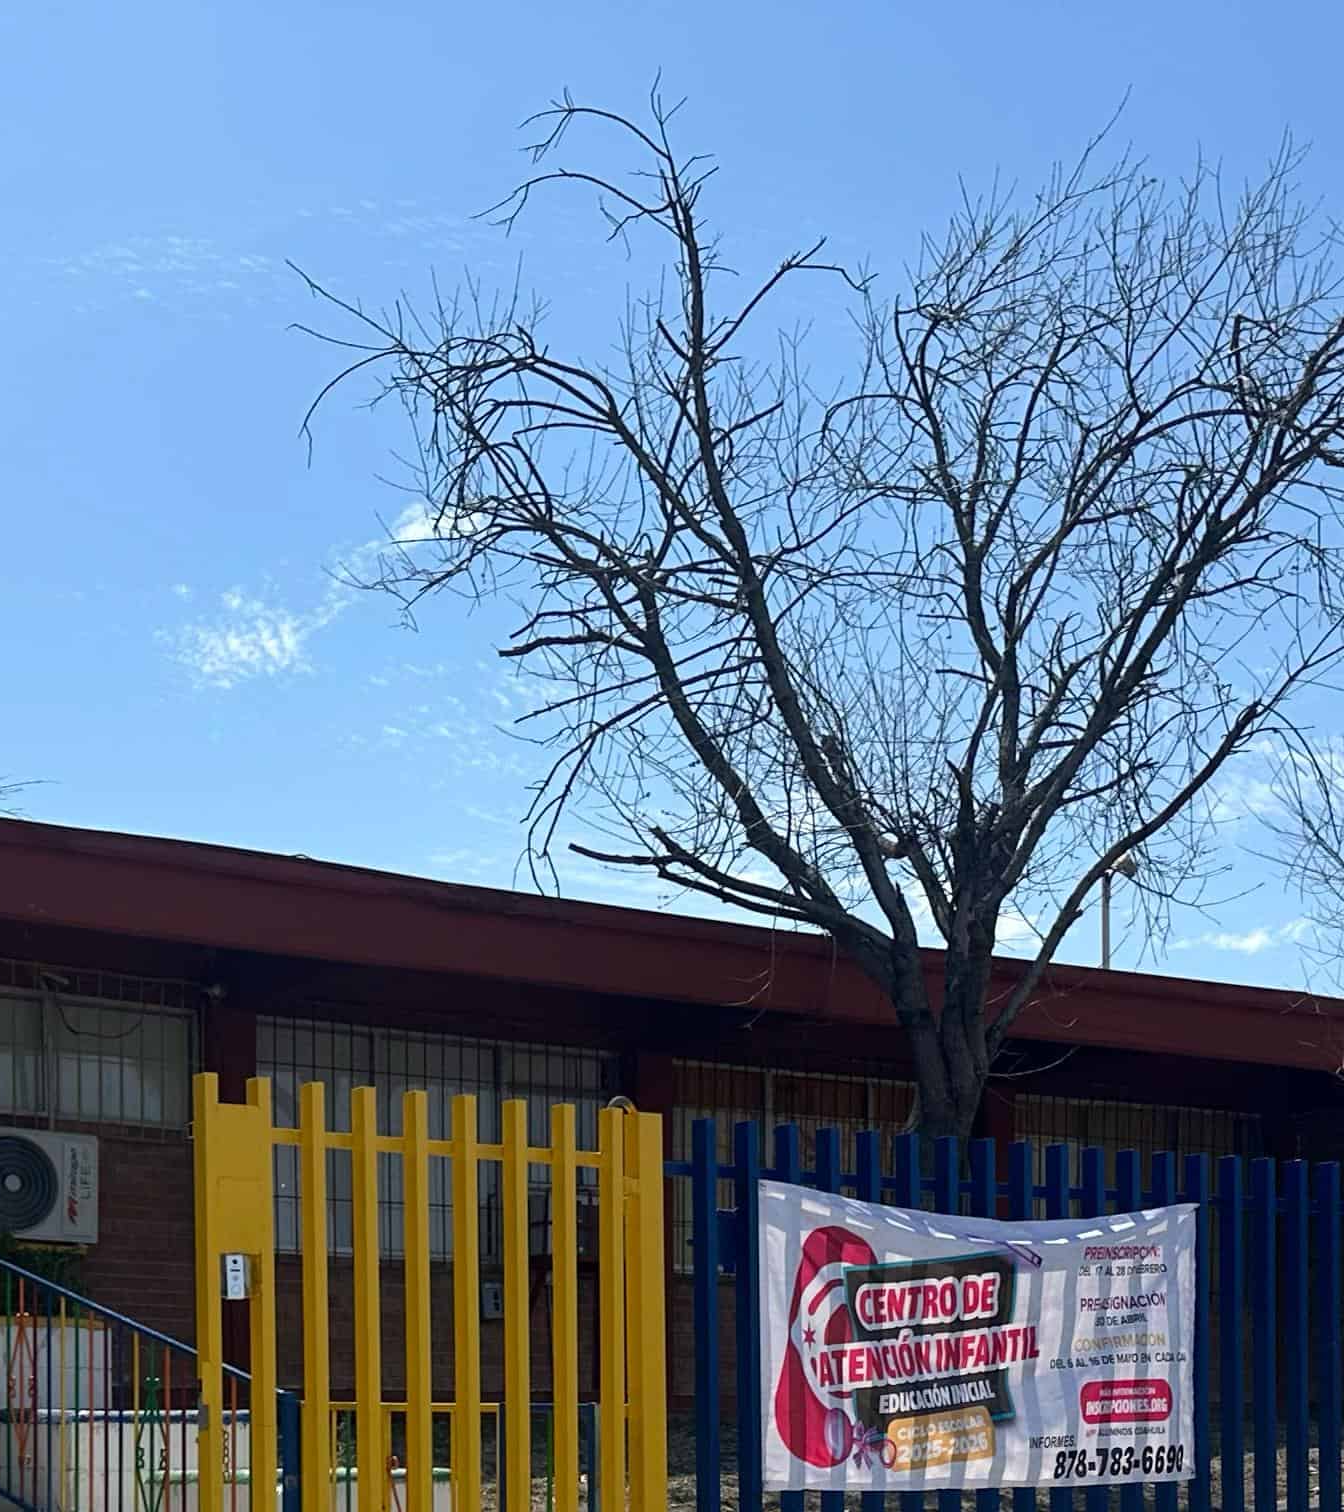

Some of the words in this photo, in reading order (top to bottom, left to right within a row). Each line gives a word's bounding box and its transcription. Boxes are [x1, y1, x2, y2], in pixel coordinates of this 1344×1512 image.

[858, 1280, 956, 1324] CENTRO
[963, 1278, 998, 1315] DE
[819, 1334, 932, 1387] ATENCIÓN
[936, 1325, 1040, 1372] INFANTIL
[1101, 1355, 1115, 1365] DE
[878, 1383, 952, 1414] EDUCACIÓN
[897, 1423, 936, 1440] CICLO
[938, 1415, 986, 1433] ESCOLAR
[898, 1431, 988, 1462] 2025-2026
[1053, 1444, 1184, 1480] 878-783-6690
